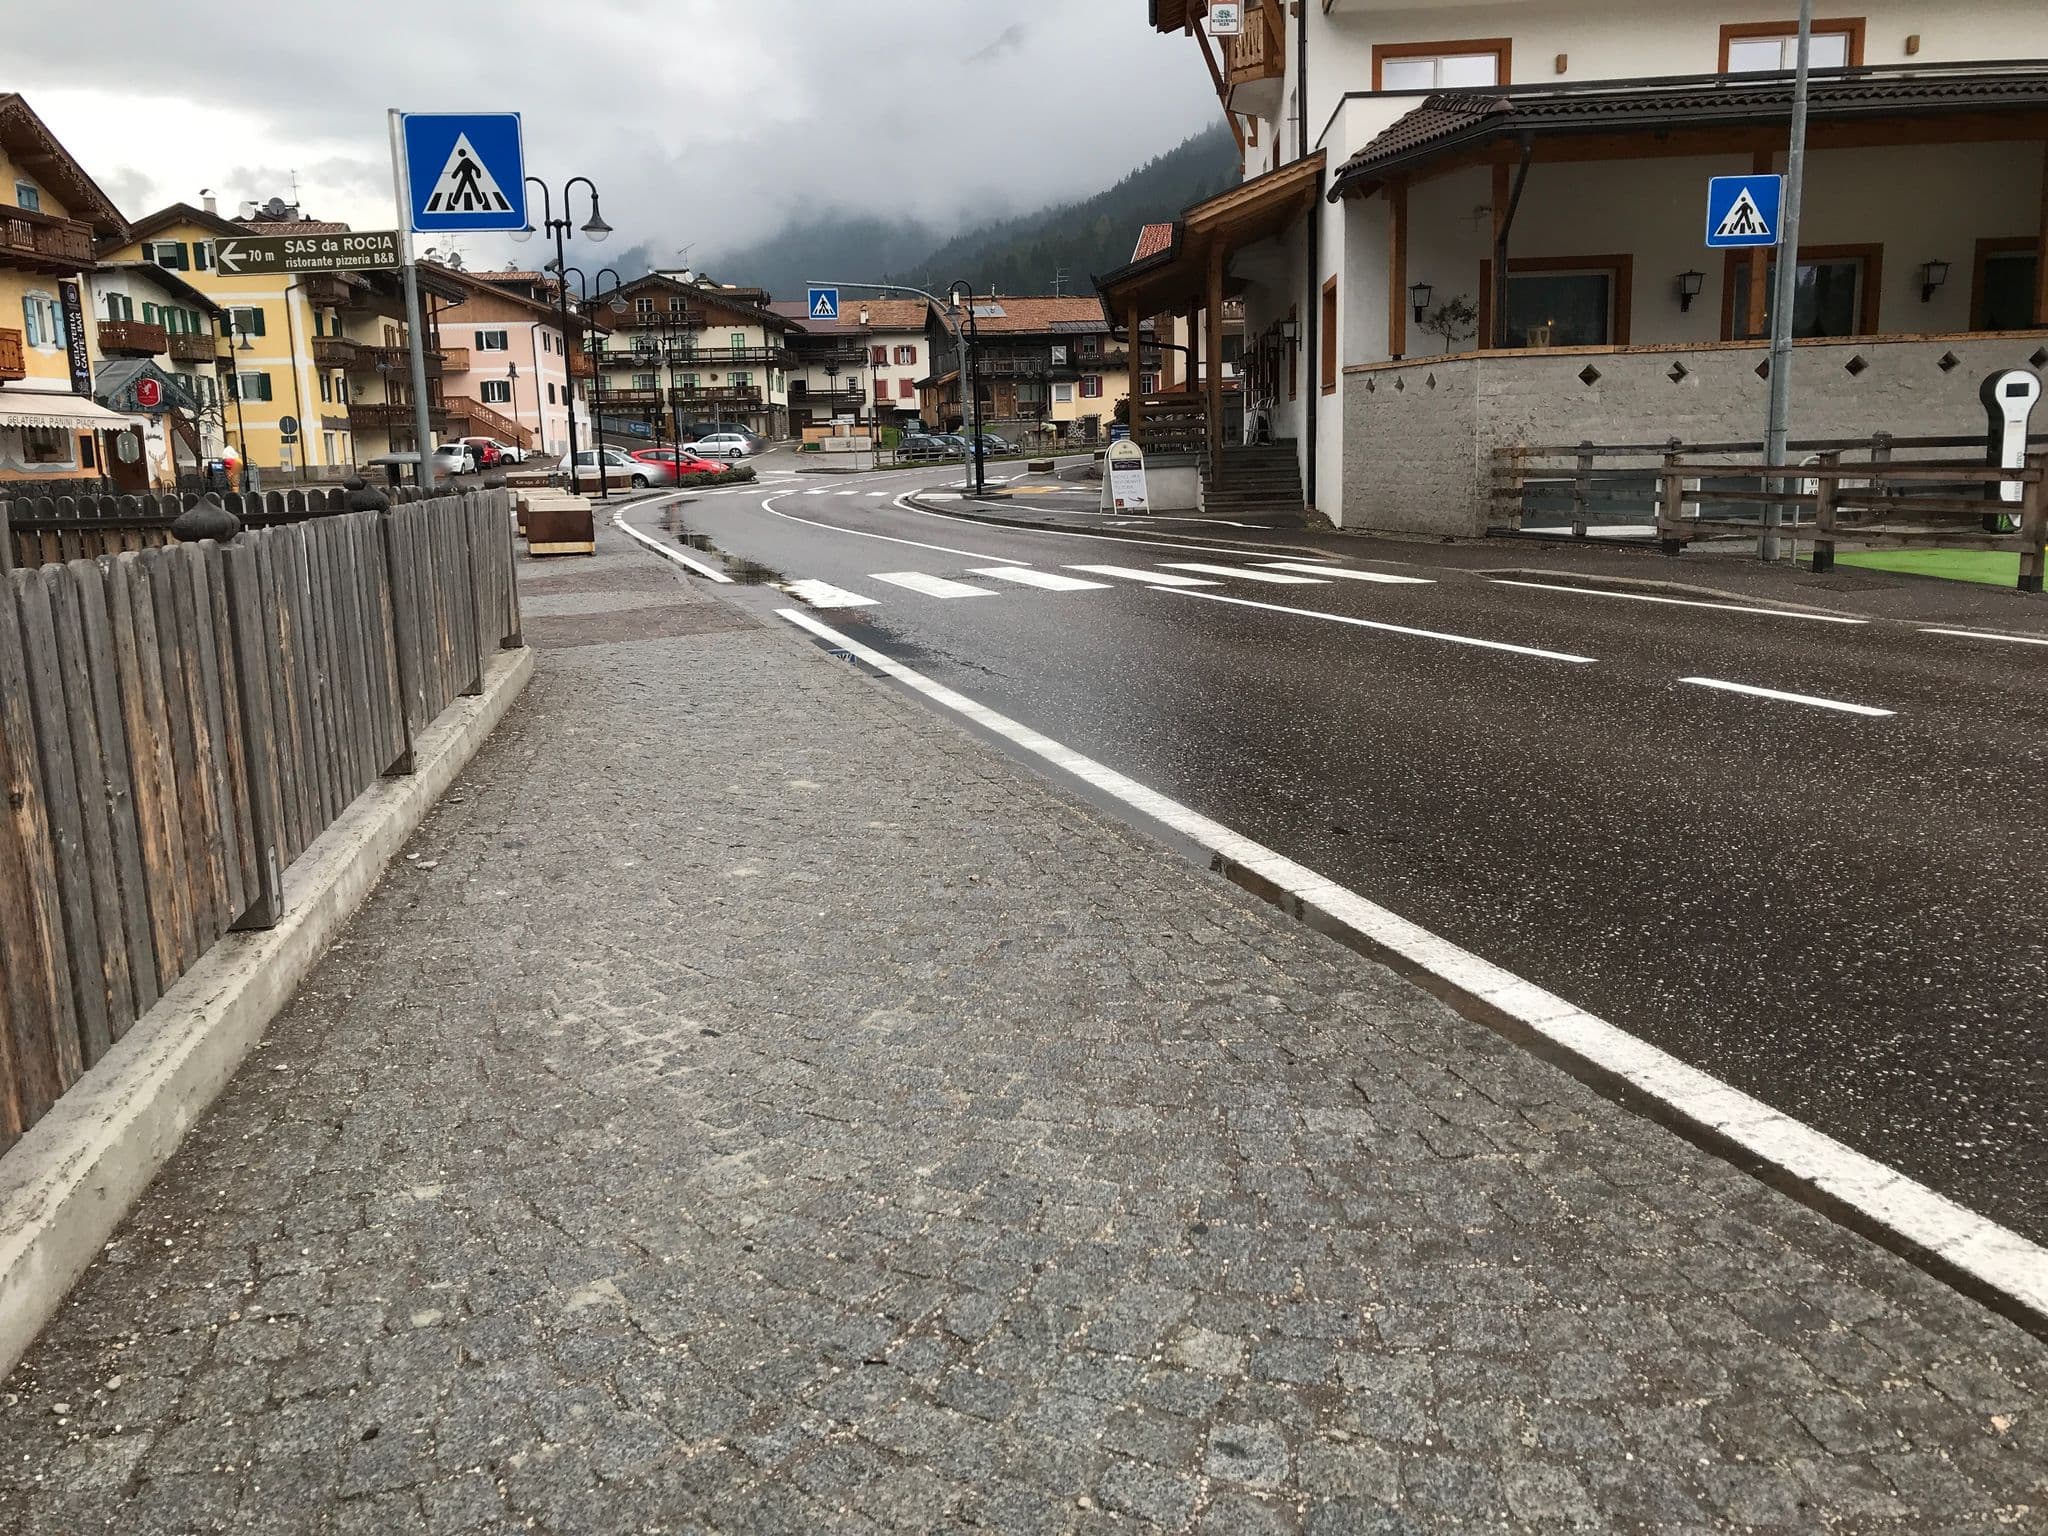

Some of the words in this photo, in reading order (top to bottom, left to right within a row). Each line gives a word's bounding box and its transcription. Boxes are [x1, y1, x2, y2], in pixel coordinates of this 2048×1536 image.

[284, 239, 317, 254] SAS
[321, 238, 339, 252] da
[343, 236, 394, 250] ROCIA
[248, 250, 262, 262] 70
[265, 252, 275, 261] m
[285, 256, 333, 268] ristorante
[335, 253, 371, 268] pizzeria
[374, 252, 395, 264] B&B
[69, 312, 81, 367] GELATERIA
[7, 415, 46, 425] GELATERIA
[49, 417, 73, 426] PANINI
